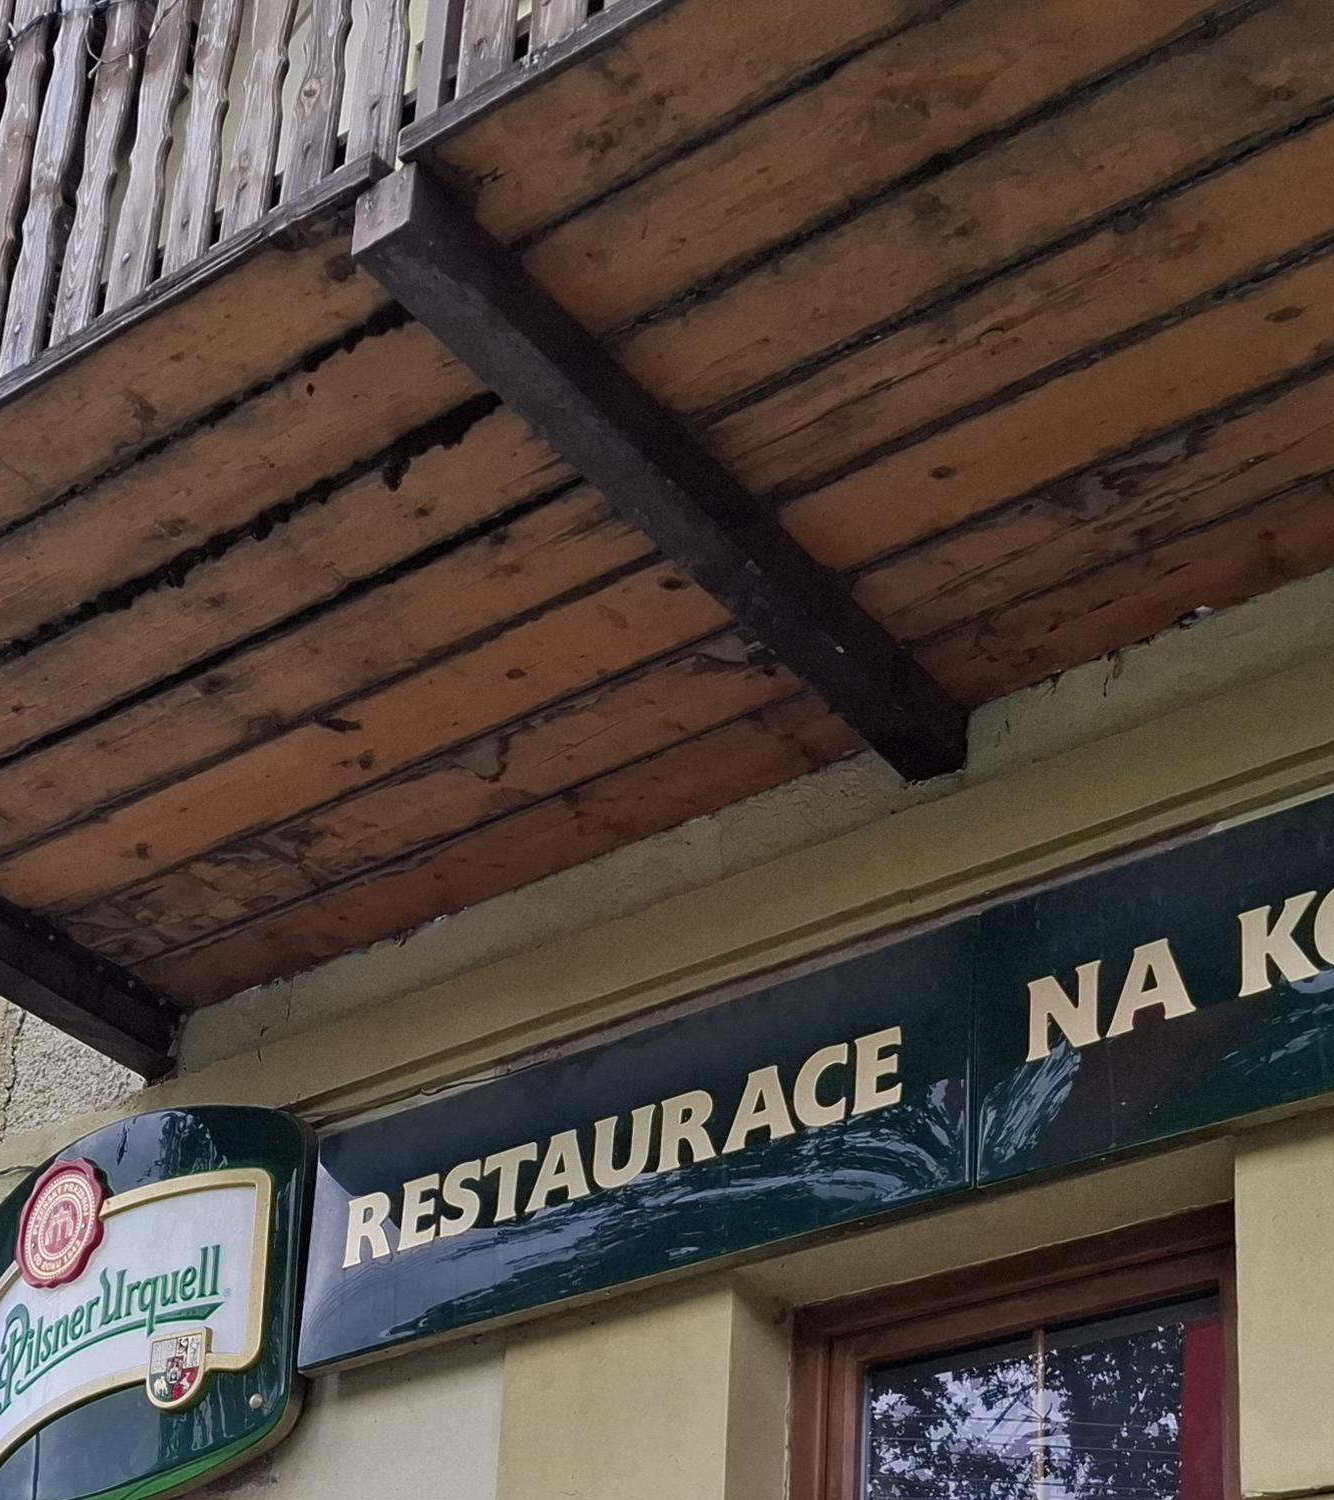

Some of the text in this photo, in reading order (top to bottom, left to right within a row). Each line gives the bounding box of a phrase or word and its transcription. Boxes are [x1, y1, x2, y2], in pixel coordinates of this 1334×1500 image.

[341, 1026, 904, 1269] RESTAURACE
[1025, 937, 1198, 1062] NA
[98, 1244, 221, 1337] Urquell
